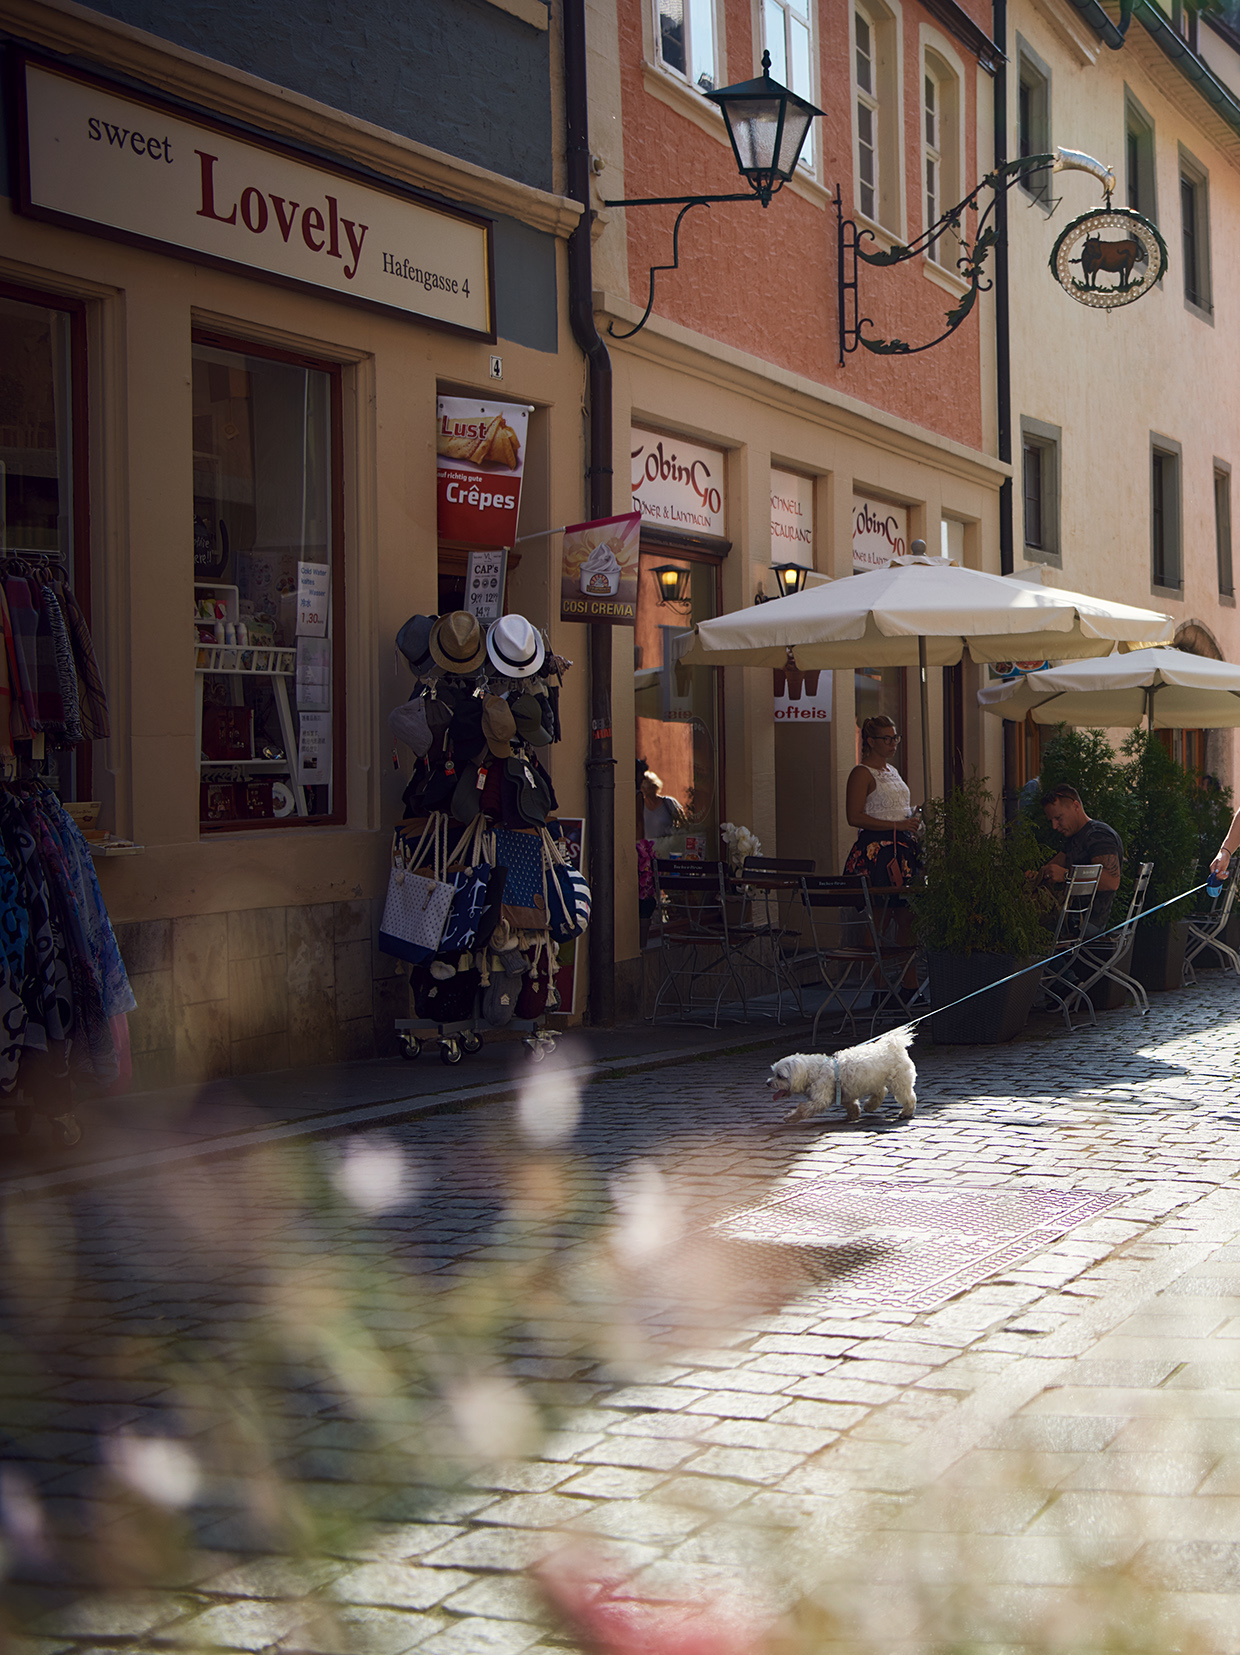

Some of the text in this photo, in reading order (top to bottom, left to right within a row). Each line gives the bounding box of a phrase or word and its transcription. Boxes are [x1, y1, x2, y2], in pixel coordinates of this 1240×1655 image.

[88, 117, 174, 164] sweet
[194, 149, 369, 280] Lovely
[382, 252, 470, 299] Hafengasse 4
[493, 359, 502, 376] 4
[441, 415, 488, 440] Lust
[447, 472, 467, 482] richtig
[446, 482, 516, 511] Crêpes
[662, 506, 670, 520] &
[301, 567, 327, 577] Cold Water
[474, 564, 499, 574] CAP's
[309, 589, 326, 597] Wasser
[563, 600, 634, 617] COSI CREMA
[774, 705, 827, 719] ofteis
